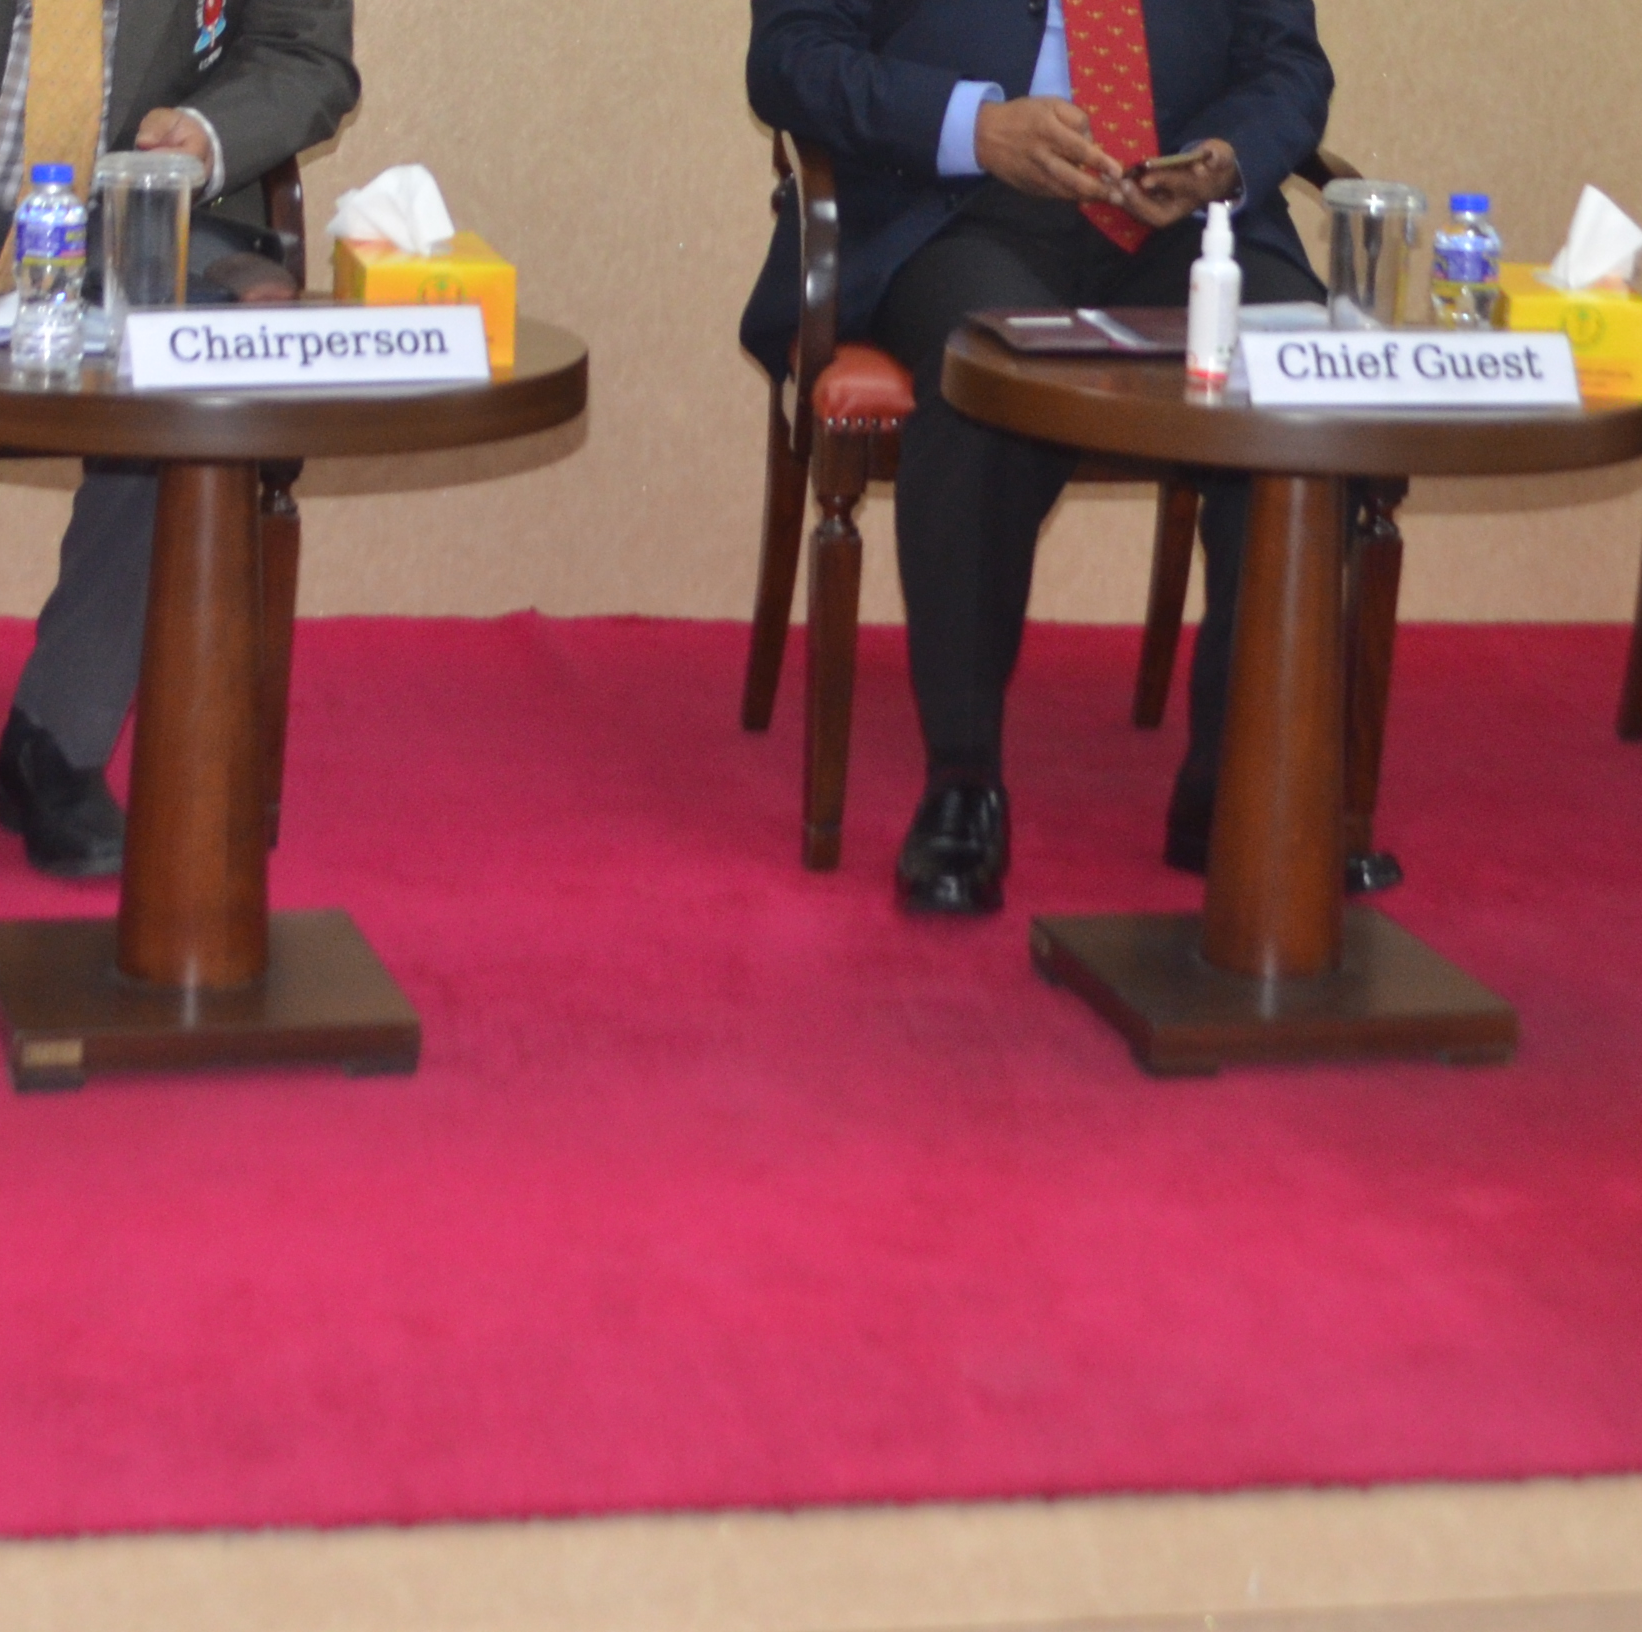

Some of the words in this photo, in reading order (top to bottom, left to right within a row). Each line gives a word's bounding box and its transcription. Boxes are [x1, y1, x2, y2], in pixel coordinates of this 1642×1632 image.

[169, 323, 449, 366] Chairperson
[1276, 342, 1398, 380] Chief
[1412, 342, 1543, 382] Guest
